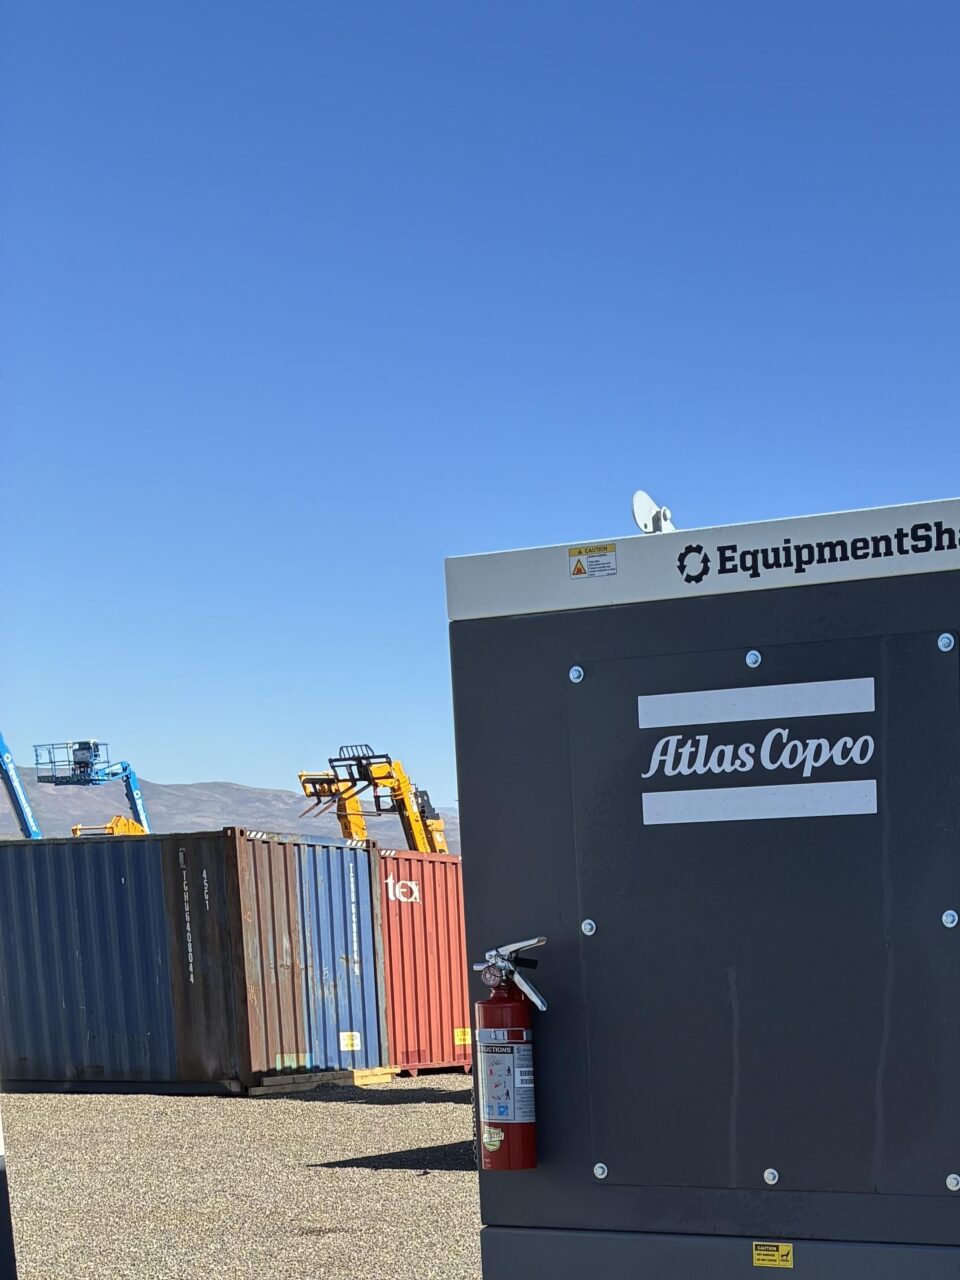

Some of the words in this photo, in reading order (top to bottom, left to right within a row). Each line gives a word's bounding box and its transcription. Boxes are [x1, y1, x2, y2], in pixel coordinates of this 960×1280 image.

[585, 545, 608, 553] CAUTION
[641, 735, 756, 778] Atlas
[760, 728, 875, 777] Copco
[202, 869, 210, 911] 45G1
